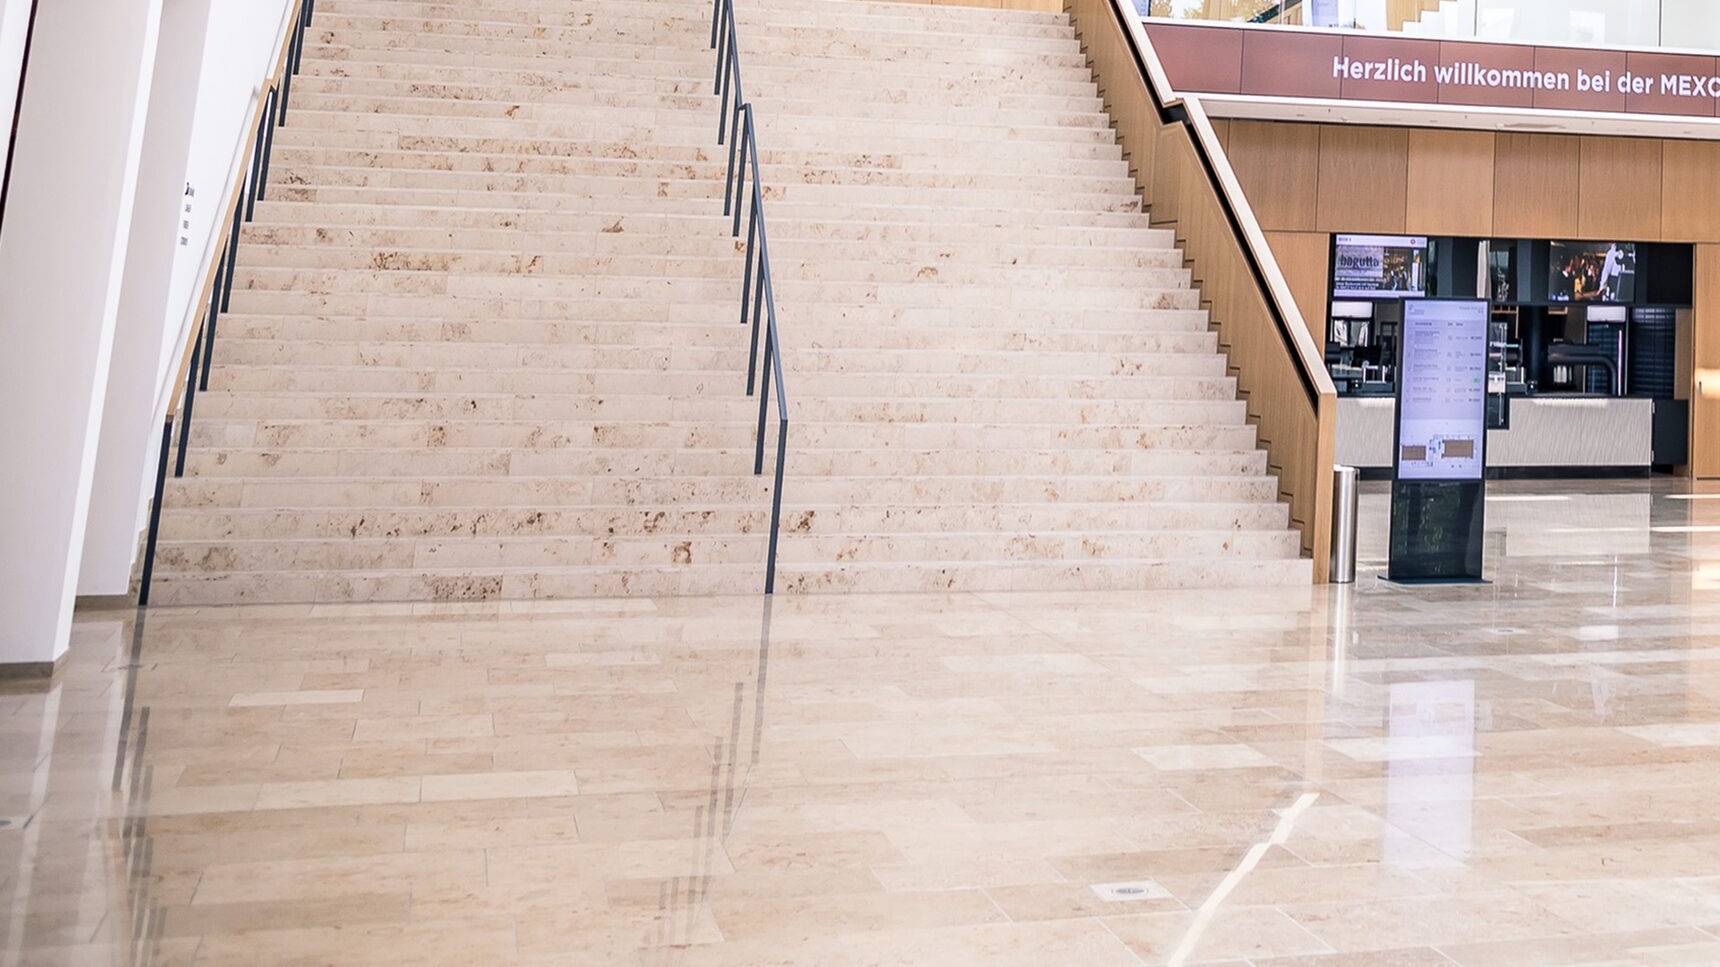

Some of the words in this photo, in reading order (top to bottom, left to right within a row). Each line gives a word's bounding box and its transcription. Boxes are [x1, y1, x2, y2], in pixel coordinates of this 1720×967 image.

[1332, 56, 1426, 82] Herzlich
[1434, 62, 1569, 90] willkommen
[1577, 69, 1610, 92] bei
[1617, 71, 1653, 94] der
